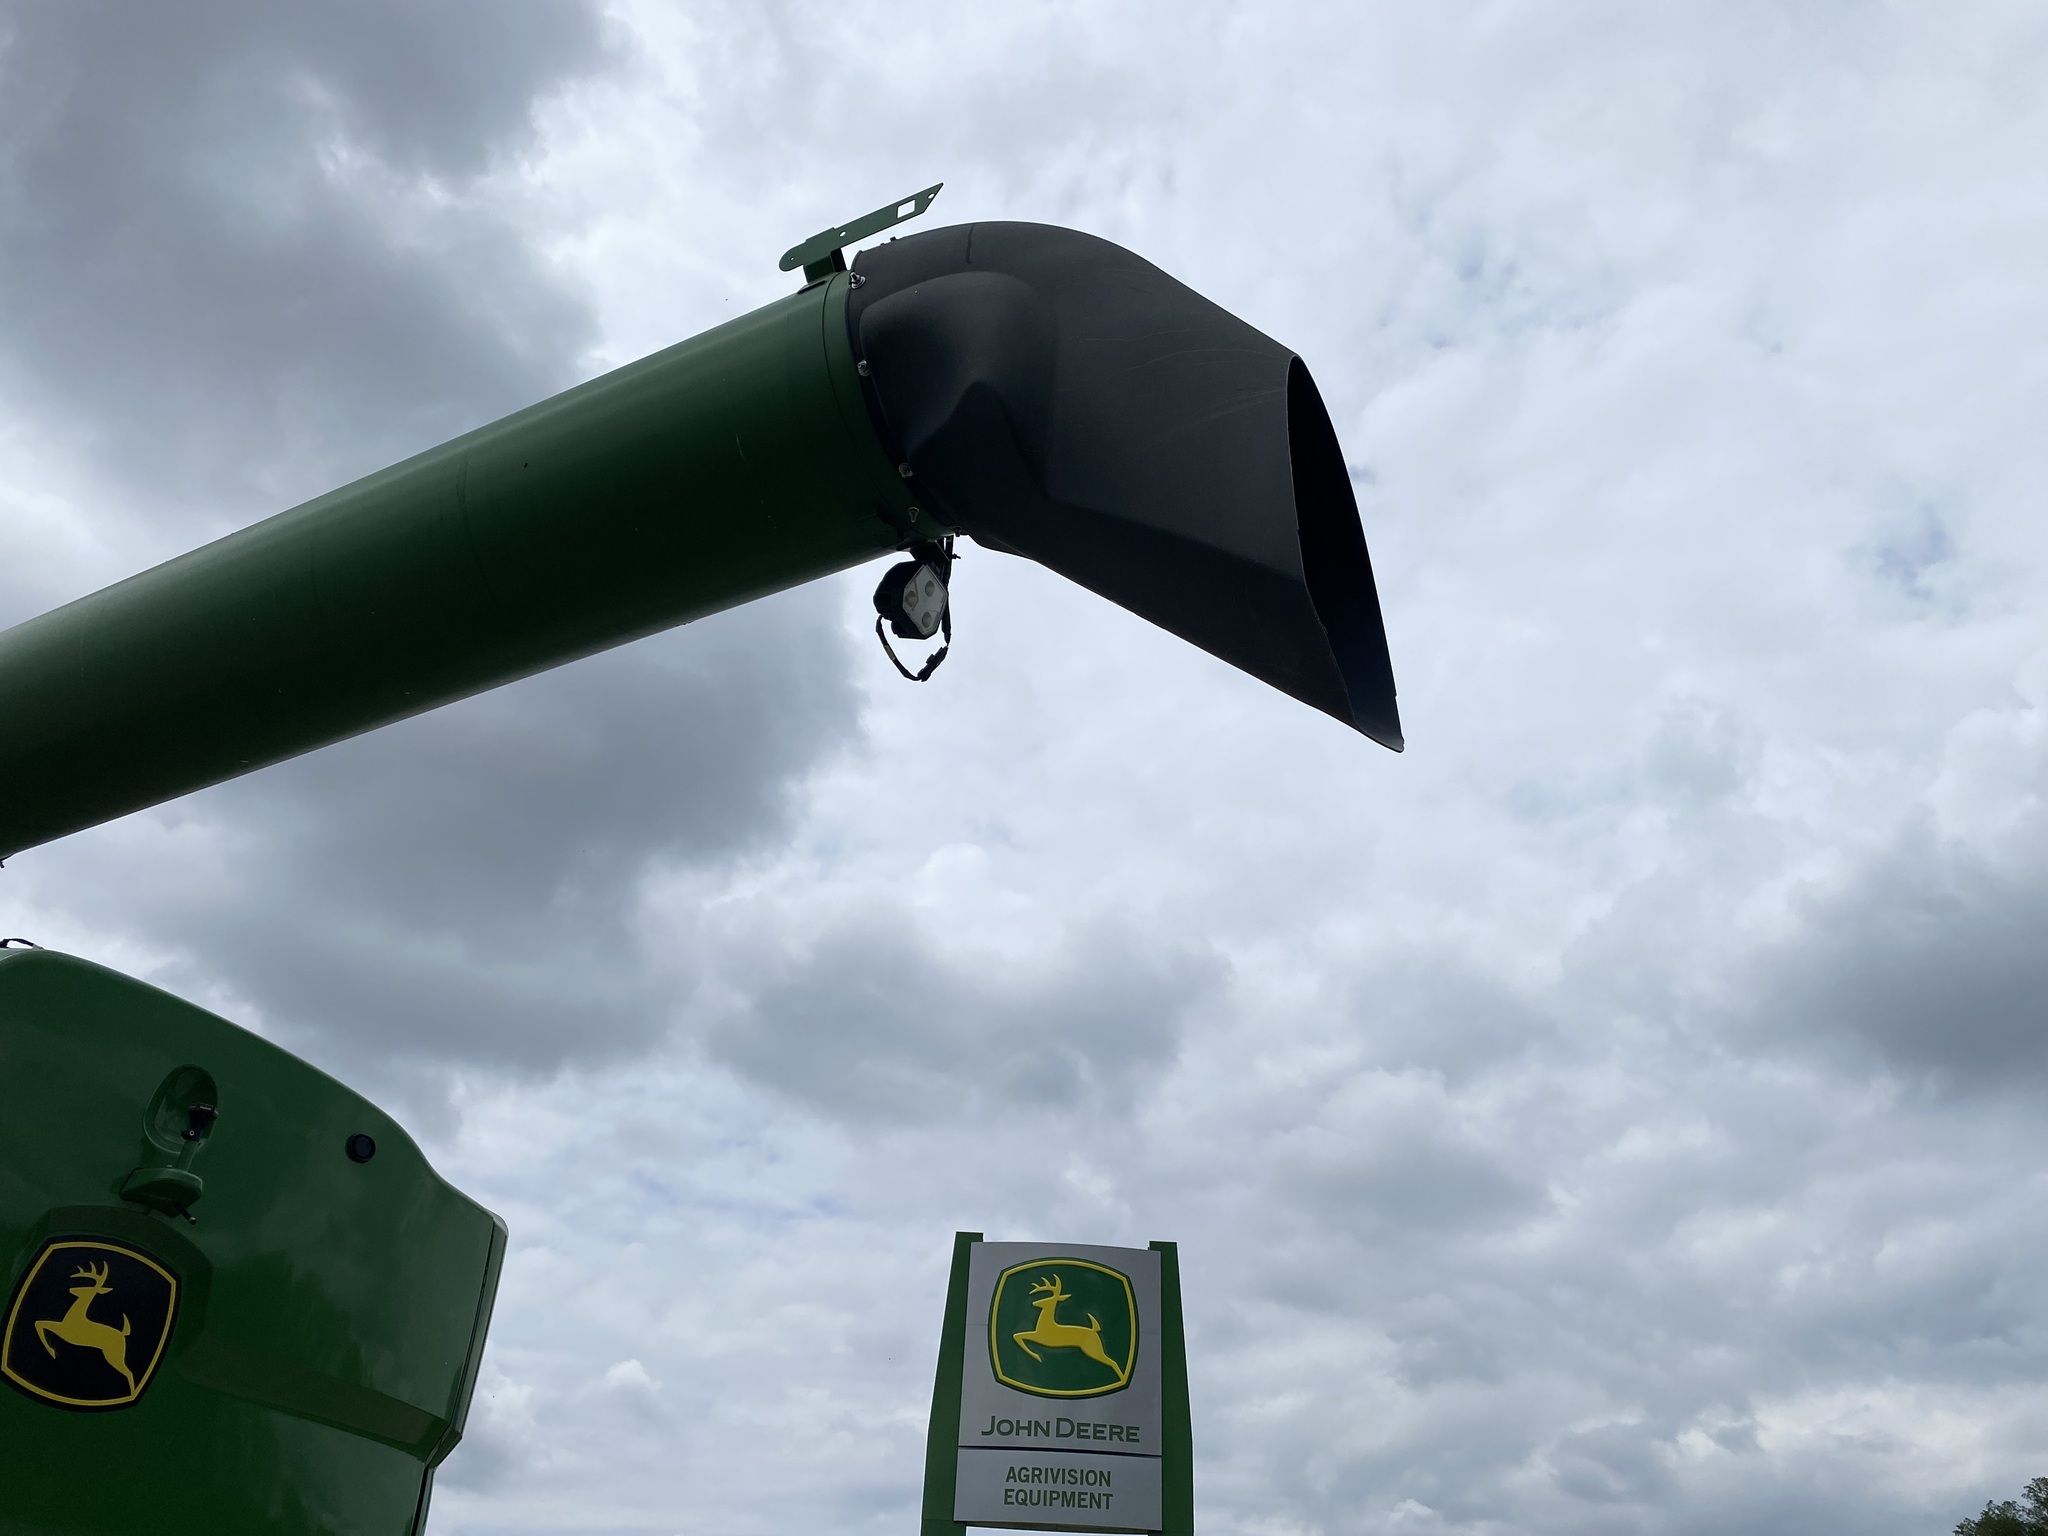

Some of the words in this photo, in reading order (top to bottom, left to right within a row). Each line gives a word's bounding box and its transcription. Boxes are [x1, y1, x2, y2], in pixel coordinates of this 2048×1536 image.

[981, 1415, 1051, 1438] JOHN
[1055, 1417, 1140, 1443] DEERE
[1005, 1466, 1112, 1487] AGRIVISION
[1003, 1488, 1114, 1510] EQUIPMENT
